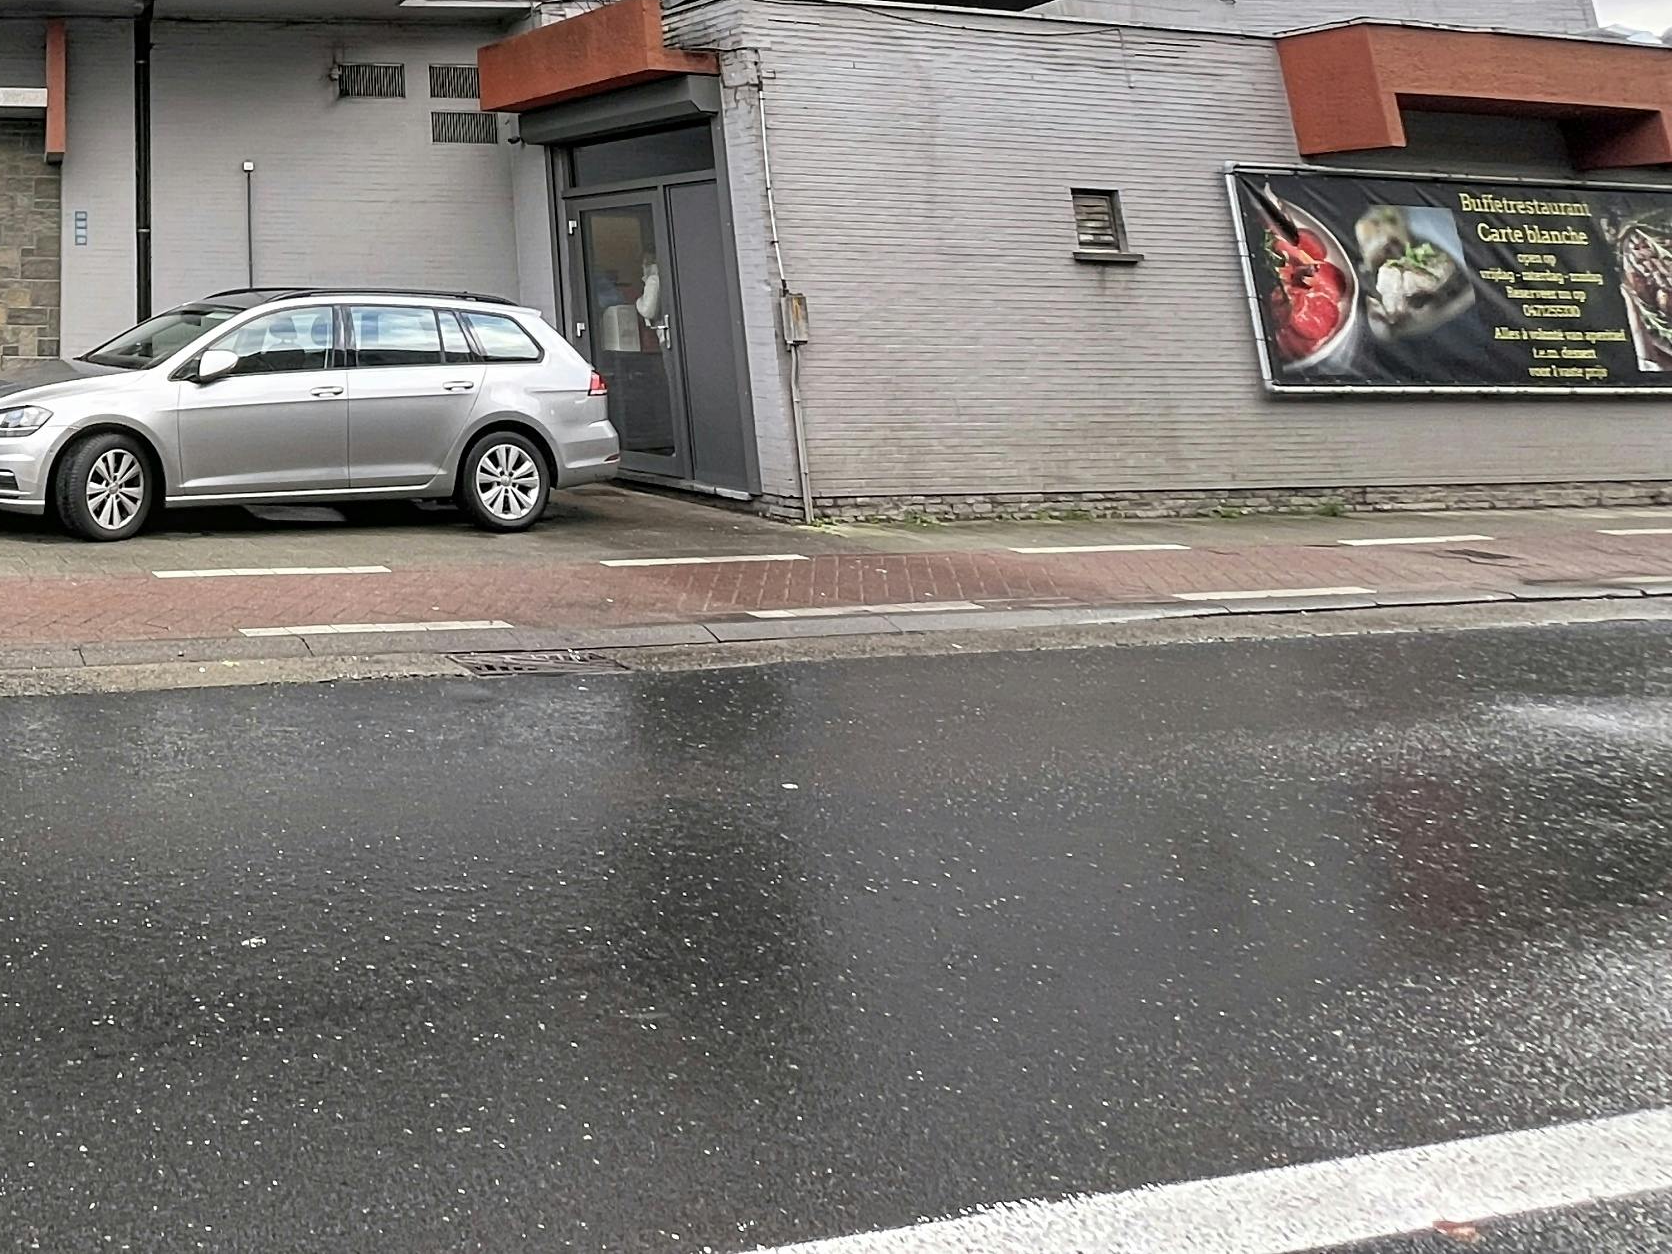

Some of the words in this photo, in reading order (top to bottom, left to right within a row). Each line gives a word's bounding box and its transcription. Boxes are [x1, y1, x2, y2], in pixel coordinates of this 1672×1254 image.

[1459, 193, 1592, 216] Buffetrestaurant
[1477, 222, 1524, 242] Carte
[1523, 224, 1589, 245] blanche
